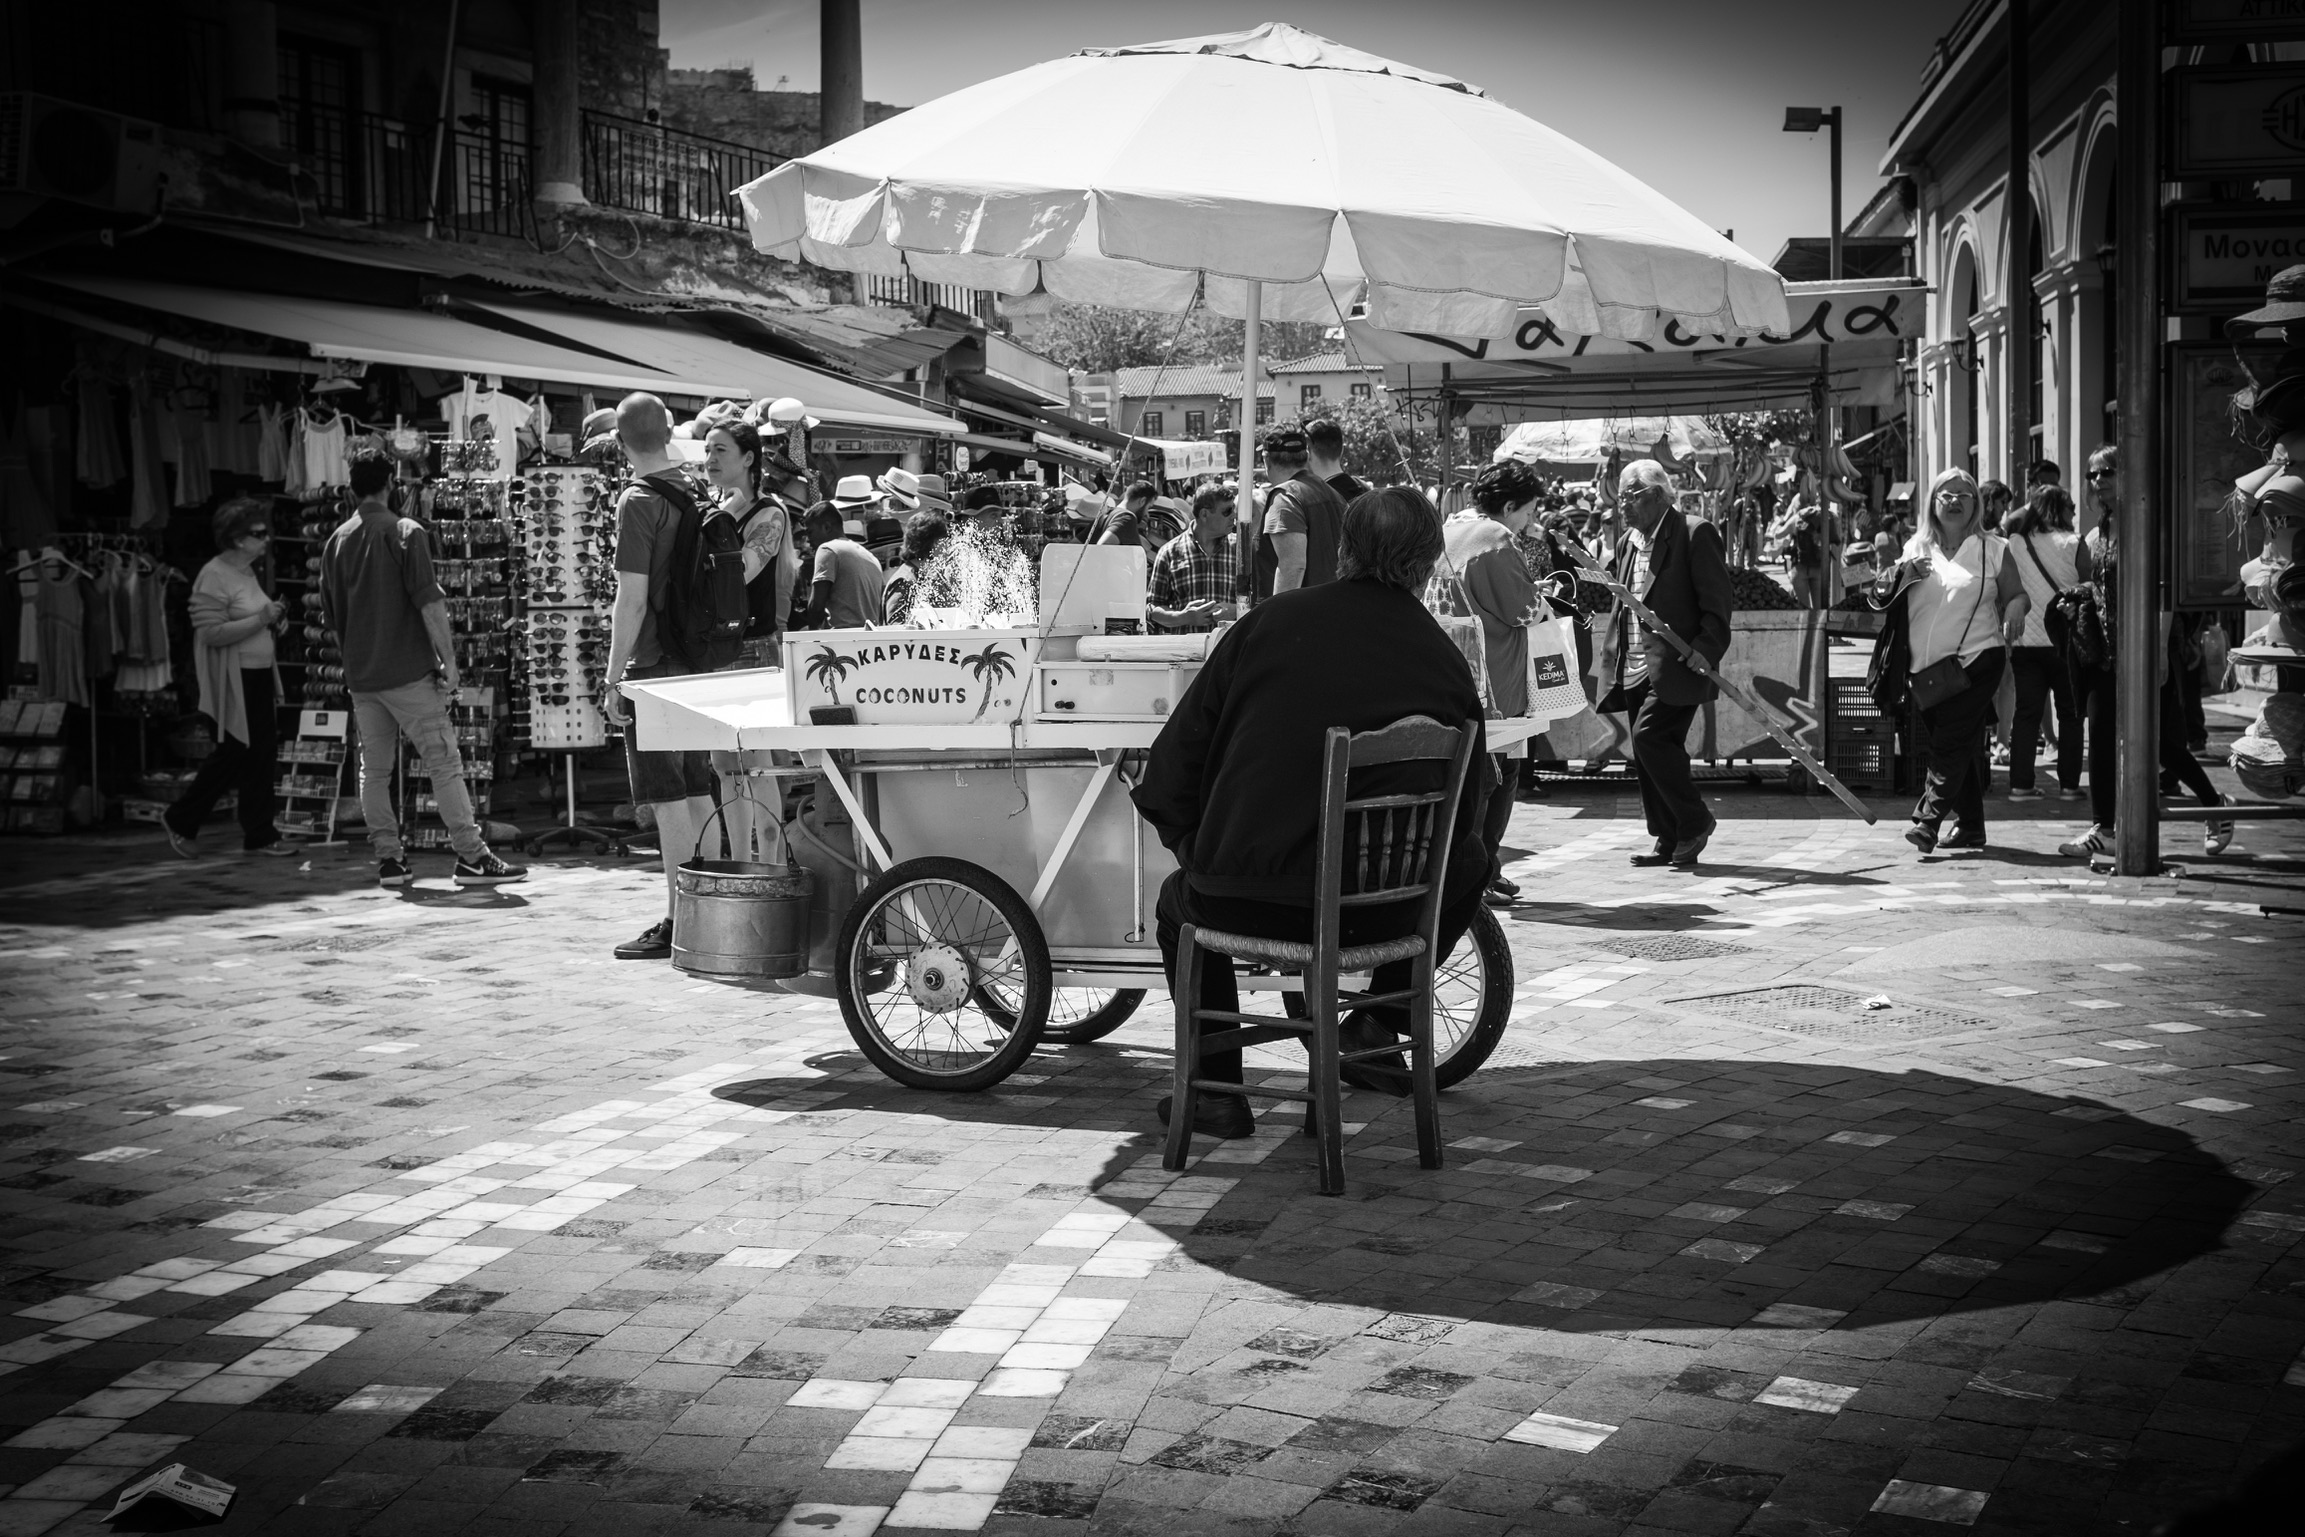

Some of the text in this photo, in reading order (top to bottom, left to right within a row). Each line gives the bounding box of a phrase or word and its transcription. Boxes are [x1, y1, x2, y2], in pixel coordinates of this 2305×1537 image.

[2240, 0, 2305, 16] ΑΤΤΙΚ
[857, 643, 962, 666] ΚΑΡΥΔΕΣ
[1538, 670, 1565, 681] KEDIMA
[855, 686, 967, 705] COCONUTS
